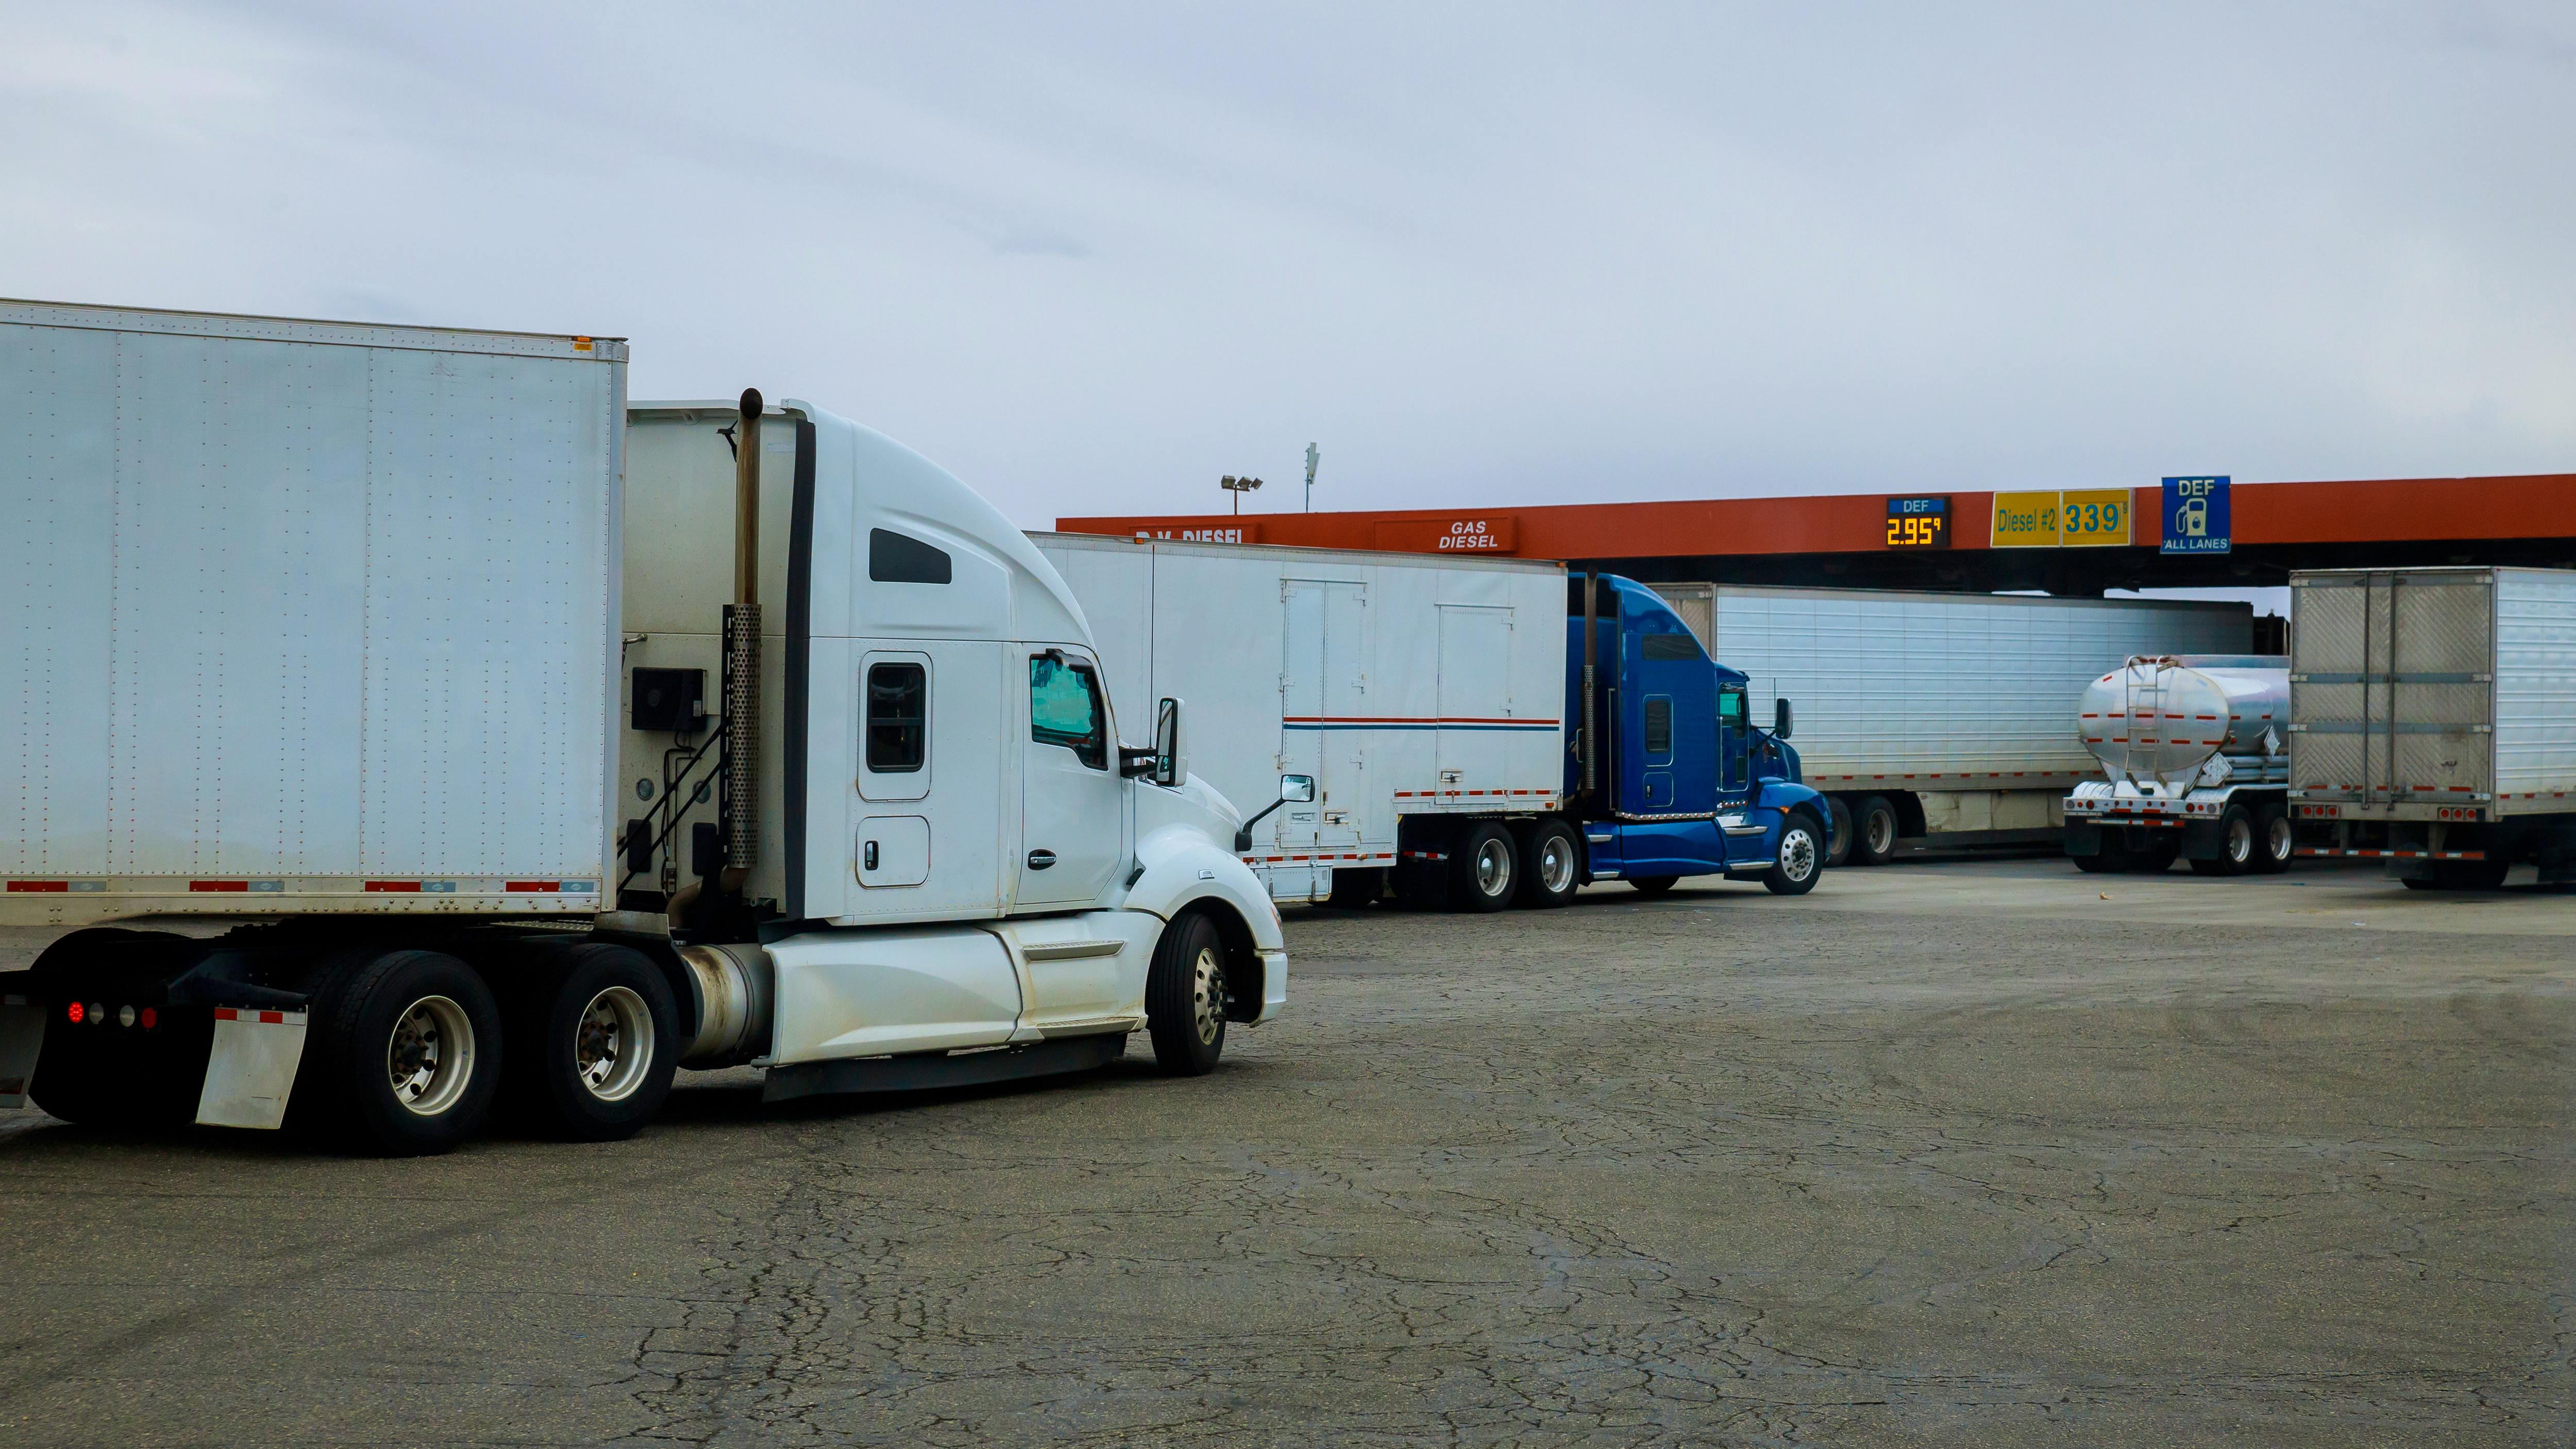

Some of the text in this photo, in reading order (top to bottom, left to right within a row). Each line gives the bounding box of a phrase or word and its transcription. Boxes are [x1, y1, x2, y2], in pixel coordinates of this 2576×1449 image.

[2178, 479, 2215, 496] DEF
[1903, 500, 1929, 513] DEF
[1451, 520, 1487, 534] GAS
[1998, 508, 2056, 532] Diesel #2
[1439, 535, 1499, 549] DIESEL
[2164, 538, 2228, 549] ALL LANES
